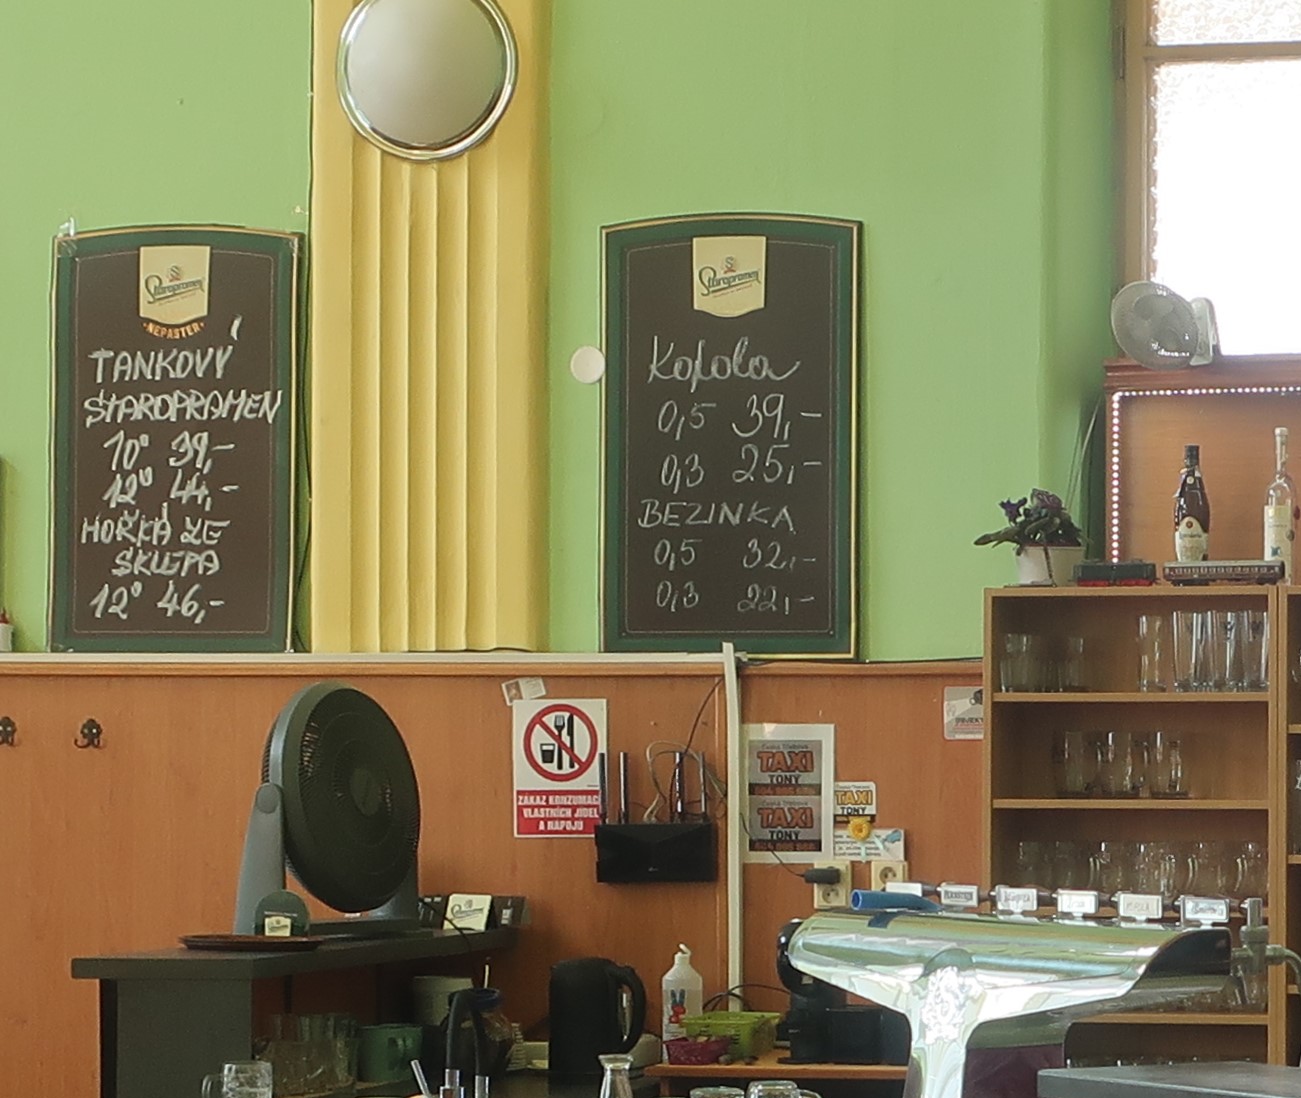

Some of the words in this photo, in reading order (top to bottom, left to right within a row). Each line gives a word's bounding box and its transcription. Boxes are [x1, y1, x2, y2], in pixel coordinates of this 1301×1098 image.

[84, 389, 283, 428] STAROPRAMEN
[657, 400, 716, 440] 0,5
[661, 454, 705, 494] 0,3
[638, 502, 797, 535] BEZINKA
[180, 516, 231, 545] ZE
[654, 539, 703, 571] 0,5
[656, 581, 700, 612] 0,3
[757, 751, 814, 772] TAXI
[768, 774, 802, 785] TONY
[548, 794, 600, 805] KONZUMAC
[834, 789, 873, 806] TAXI
[757, 807, 814, 829] TAXI
[840, 806, 867, 815] TONY
[538, 820, 549, 830] A
[769, 830, 802, 841] TONY
